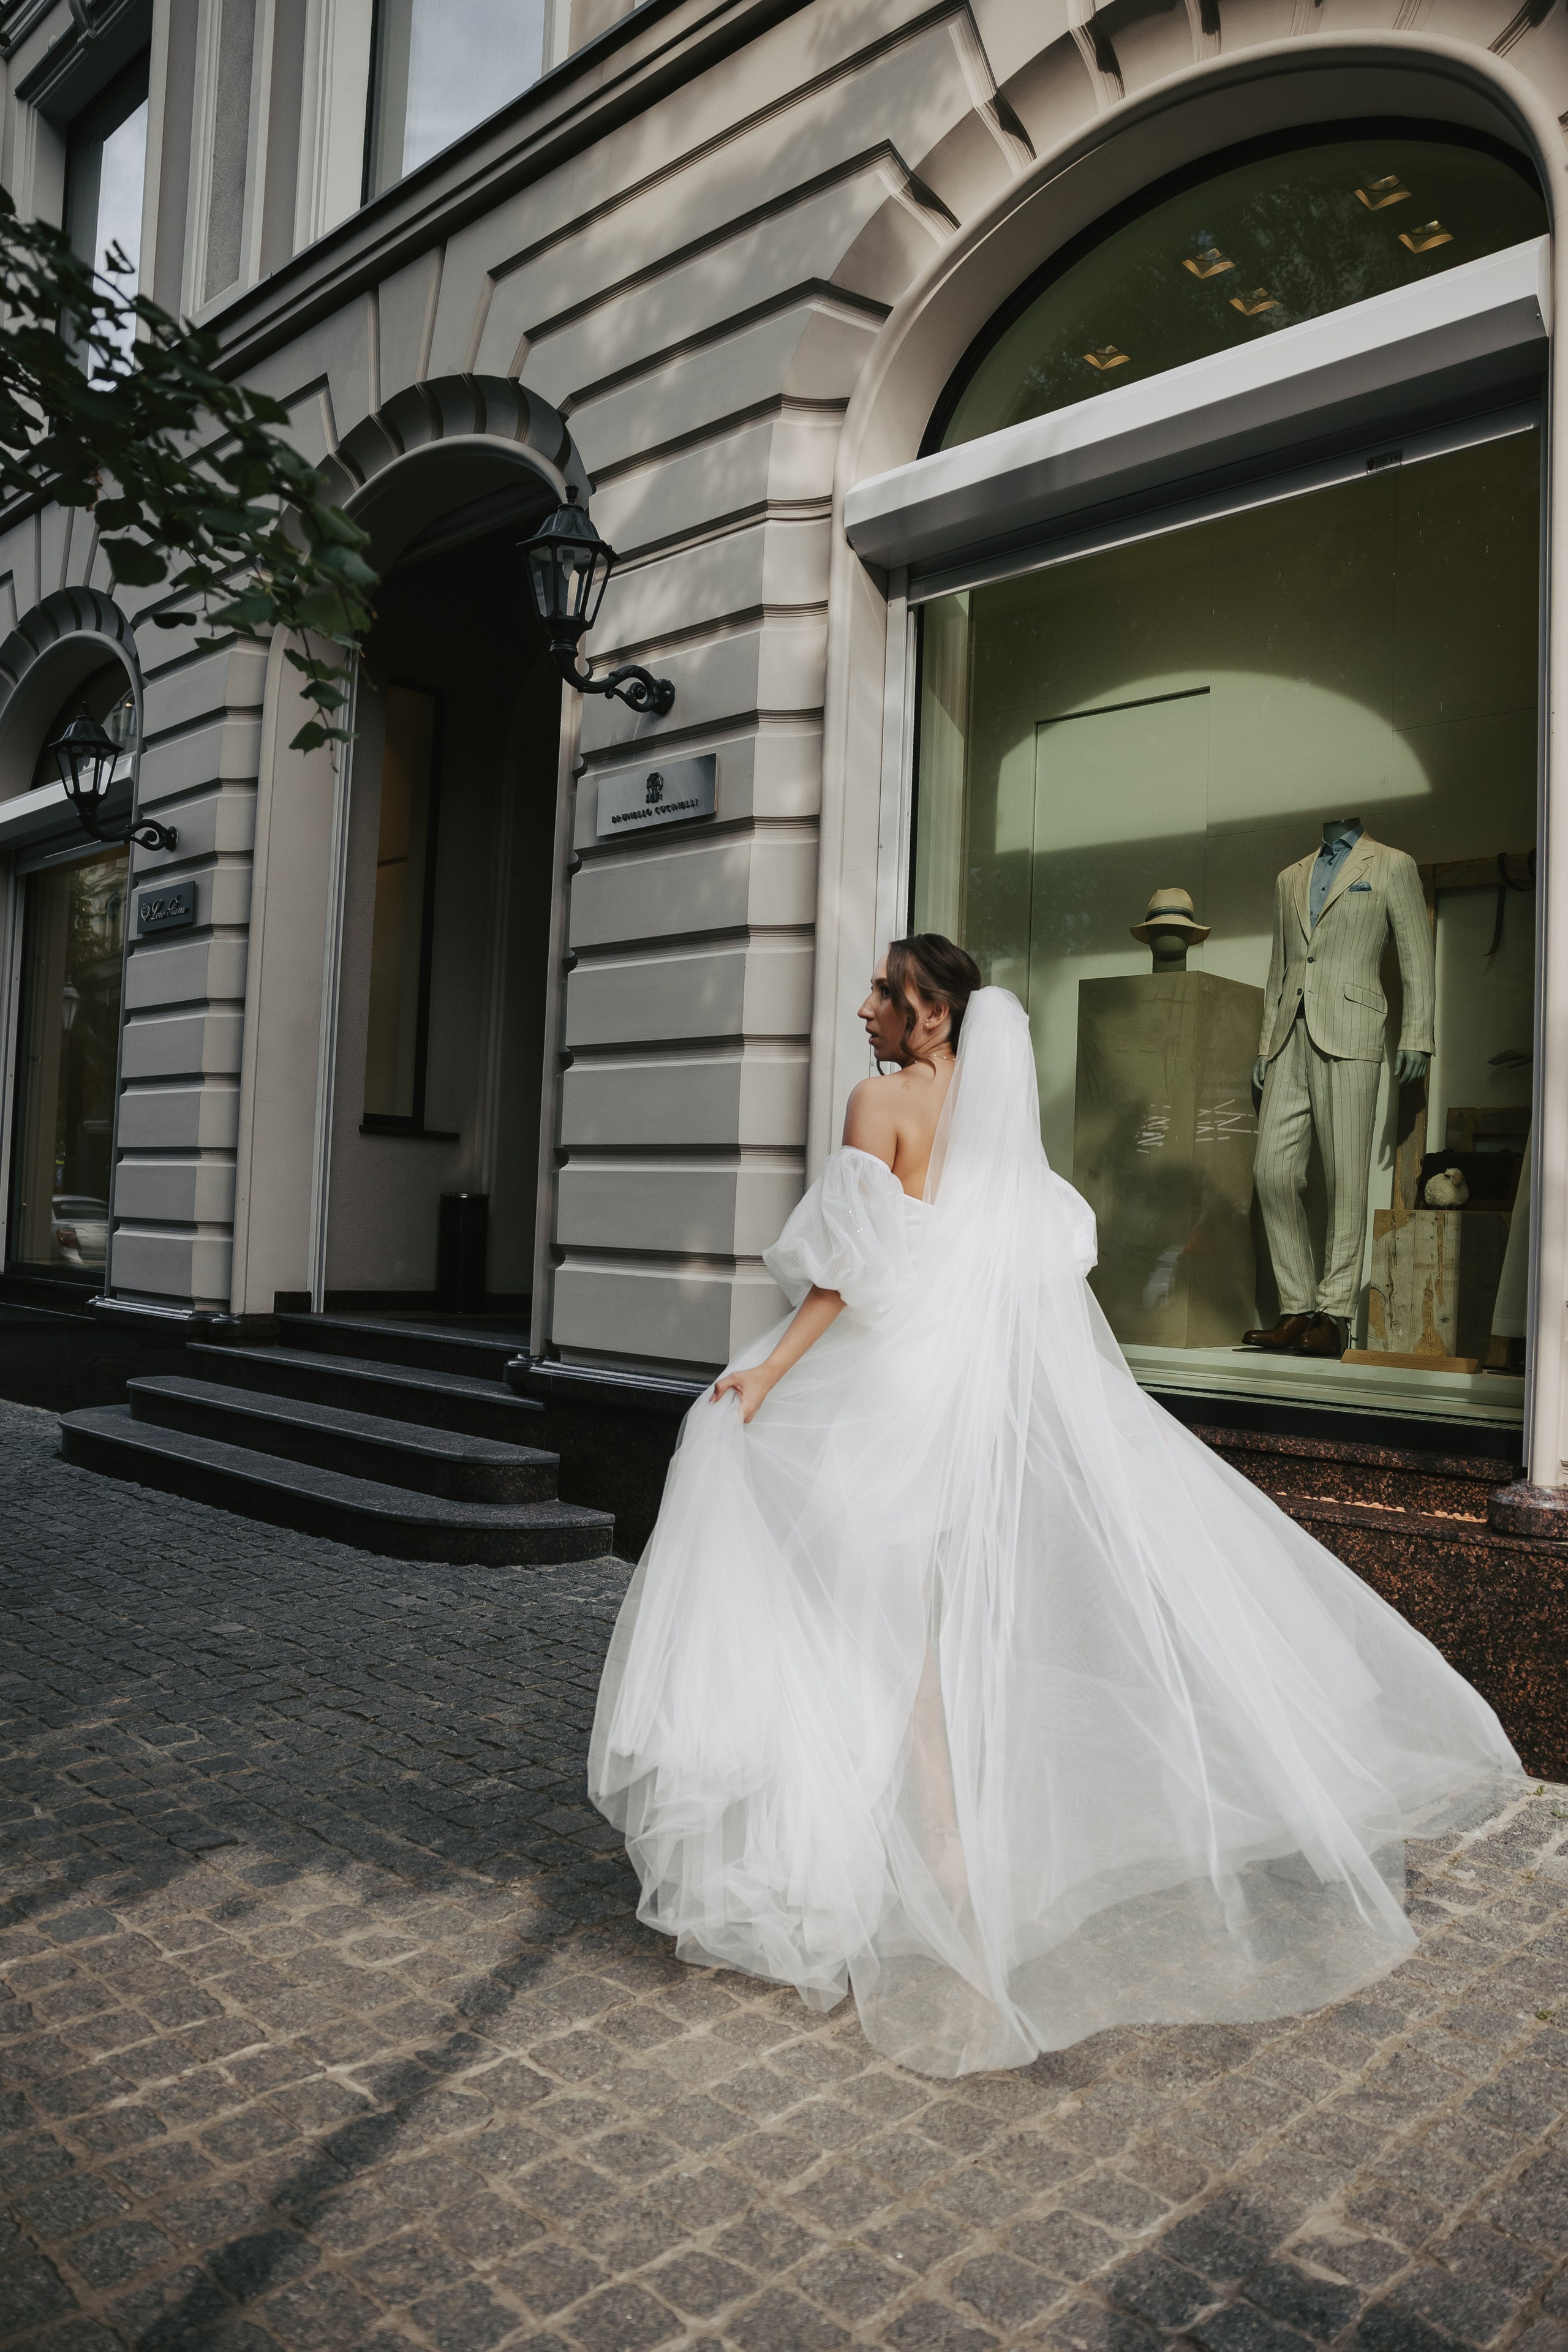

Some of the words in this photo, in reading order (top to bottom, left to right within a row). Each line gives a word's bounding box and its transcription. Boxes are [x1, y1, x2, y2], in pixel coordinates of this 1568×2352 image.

[611, 809, 652, 824] BRUNELLO
[654, 799, 698, 815] CUCINELLI
[149, 899, 165, 921] Loro
[166, 897, 186, 916] Piana
